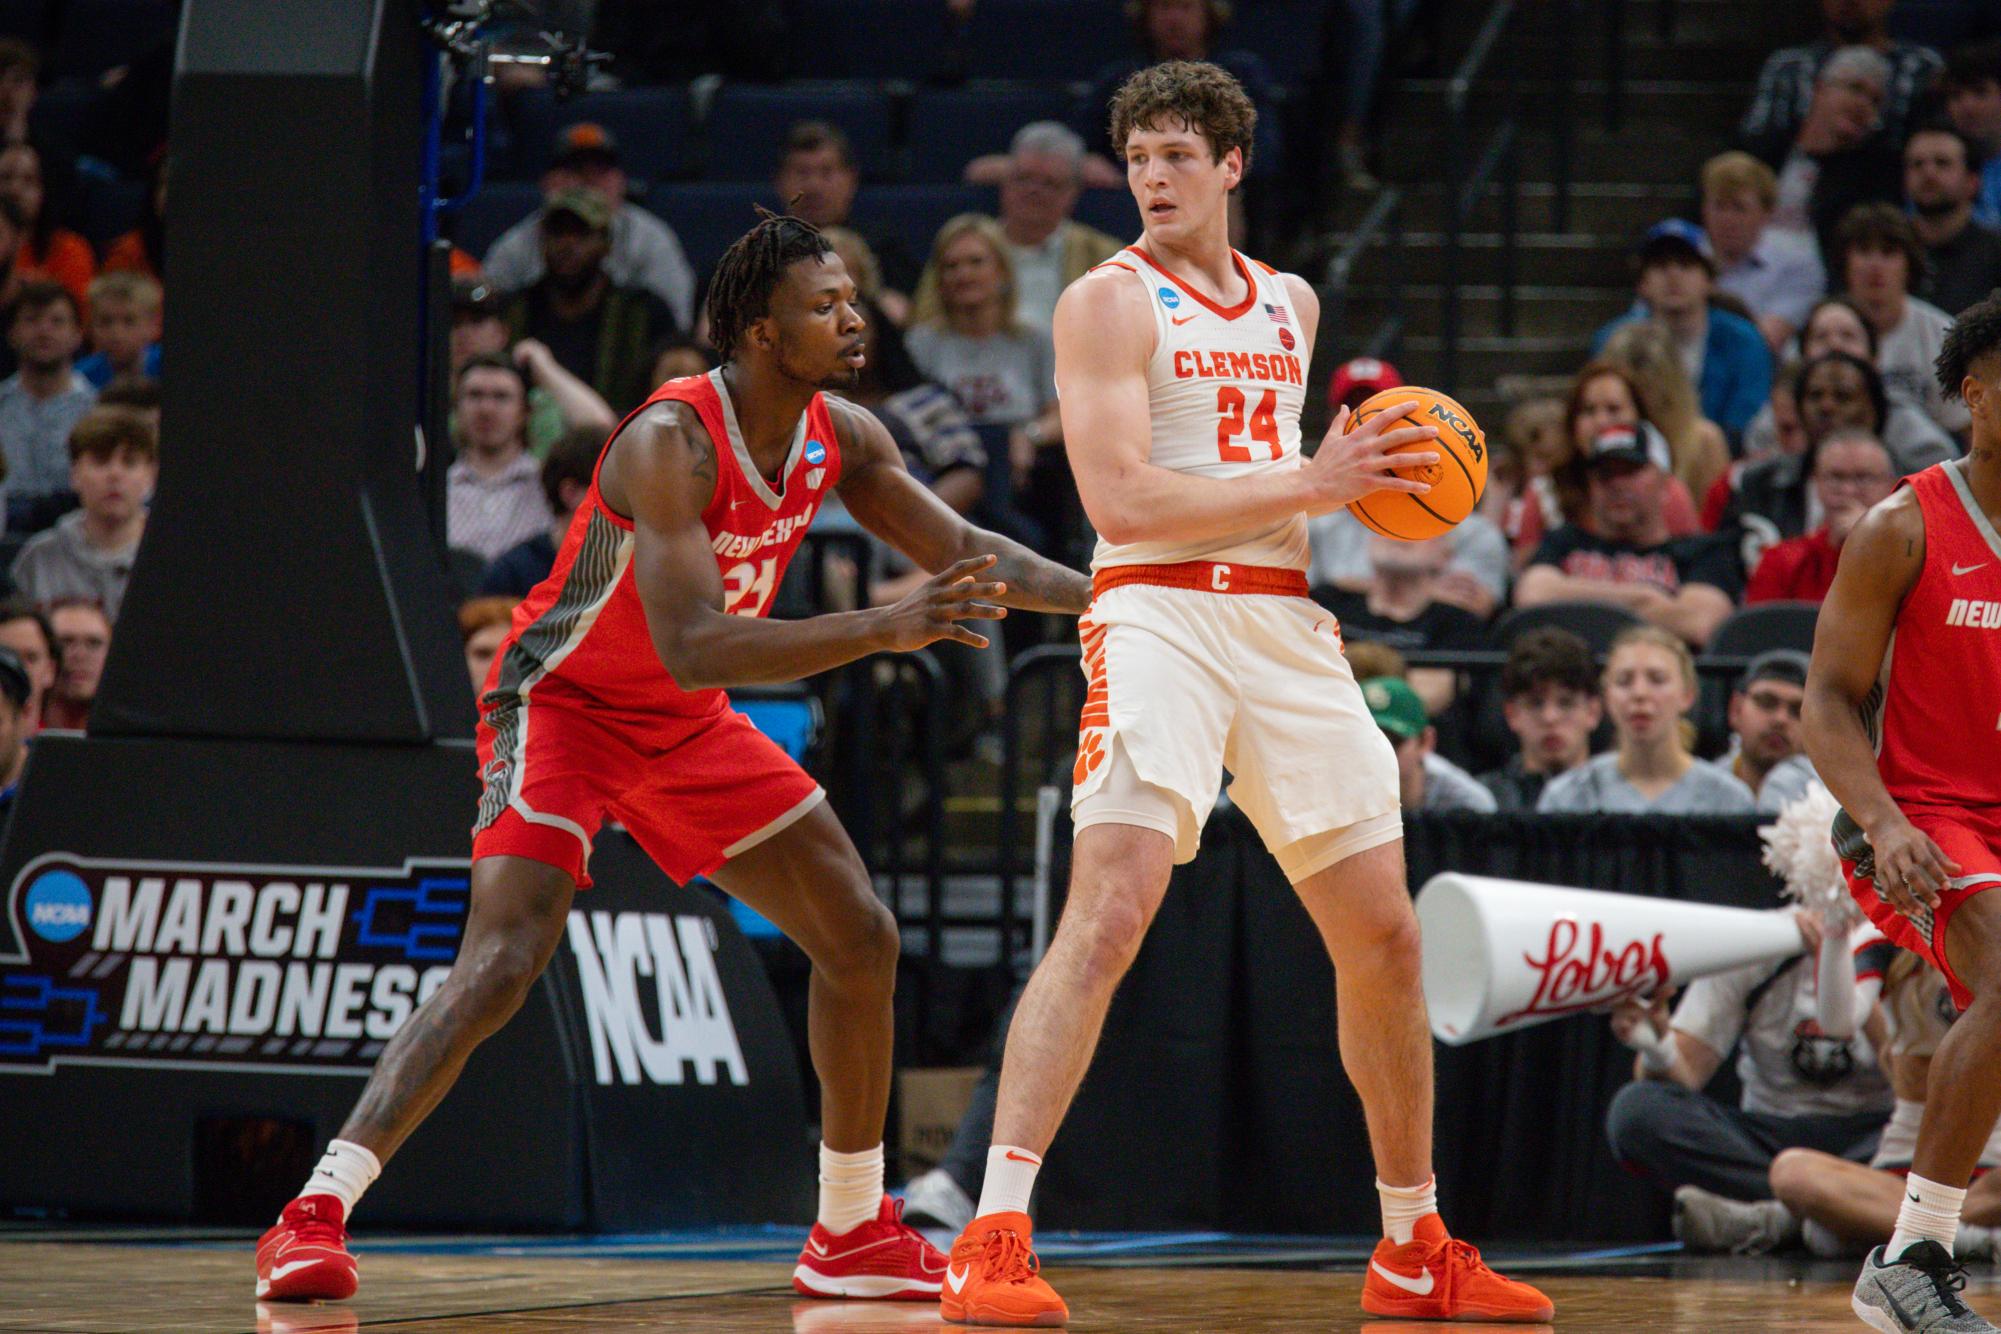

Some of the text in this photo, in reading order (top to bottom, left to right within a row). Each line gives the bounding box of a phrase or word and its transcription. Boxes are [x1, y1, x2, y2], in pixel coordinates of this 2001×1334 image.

[1174, 350, 1303, 386] CLEMSON
[1217, 386, 1283, 462] 24
[1428, 403, 1483, 464] NCAA
[1211, 564, 1231, 591] C
[1945, 599, 2001, 629] NEW
[92, 876, 350, 958] MARCH
[567, 909, 750, 1085] NCAA
[1496, 917, 1670, 1024] Lobos
